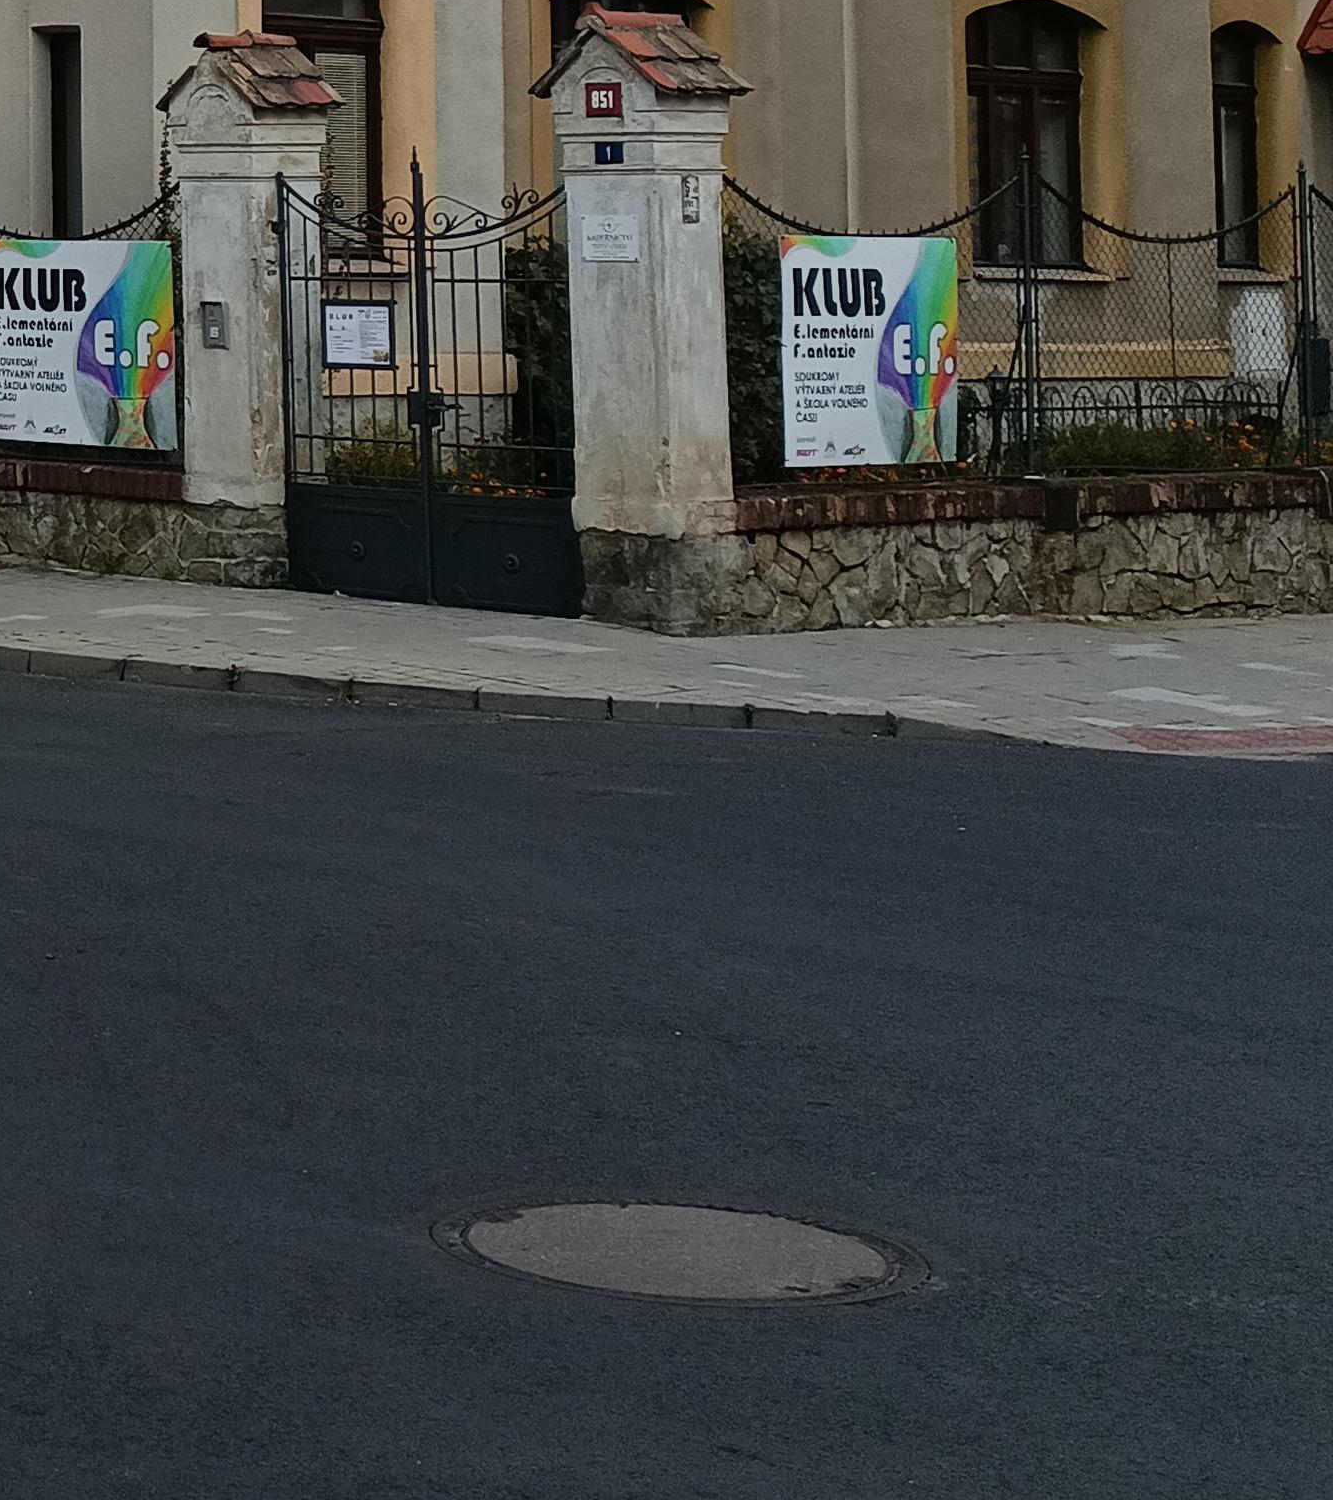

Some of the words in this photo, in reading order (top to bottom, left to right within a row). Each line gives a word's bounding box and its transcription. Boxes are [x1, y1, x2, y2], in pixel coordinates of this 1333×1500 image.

[591, 90, 613, 108] 851
[605, 145, 611, 161] 1
[792, 267, 886, 317] KLUB
[793, 323, 874, 339] E.lementární
[3, 379, 28, 390] ŠKOLA
[30, 381, 67, 393] VOLNÉHO
[796, 399, 801, 408] A
